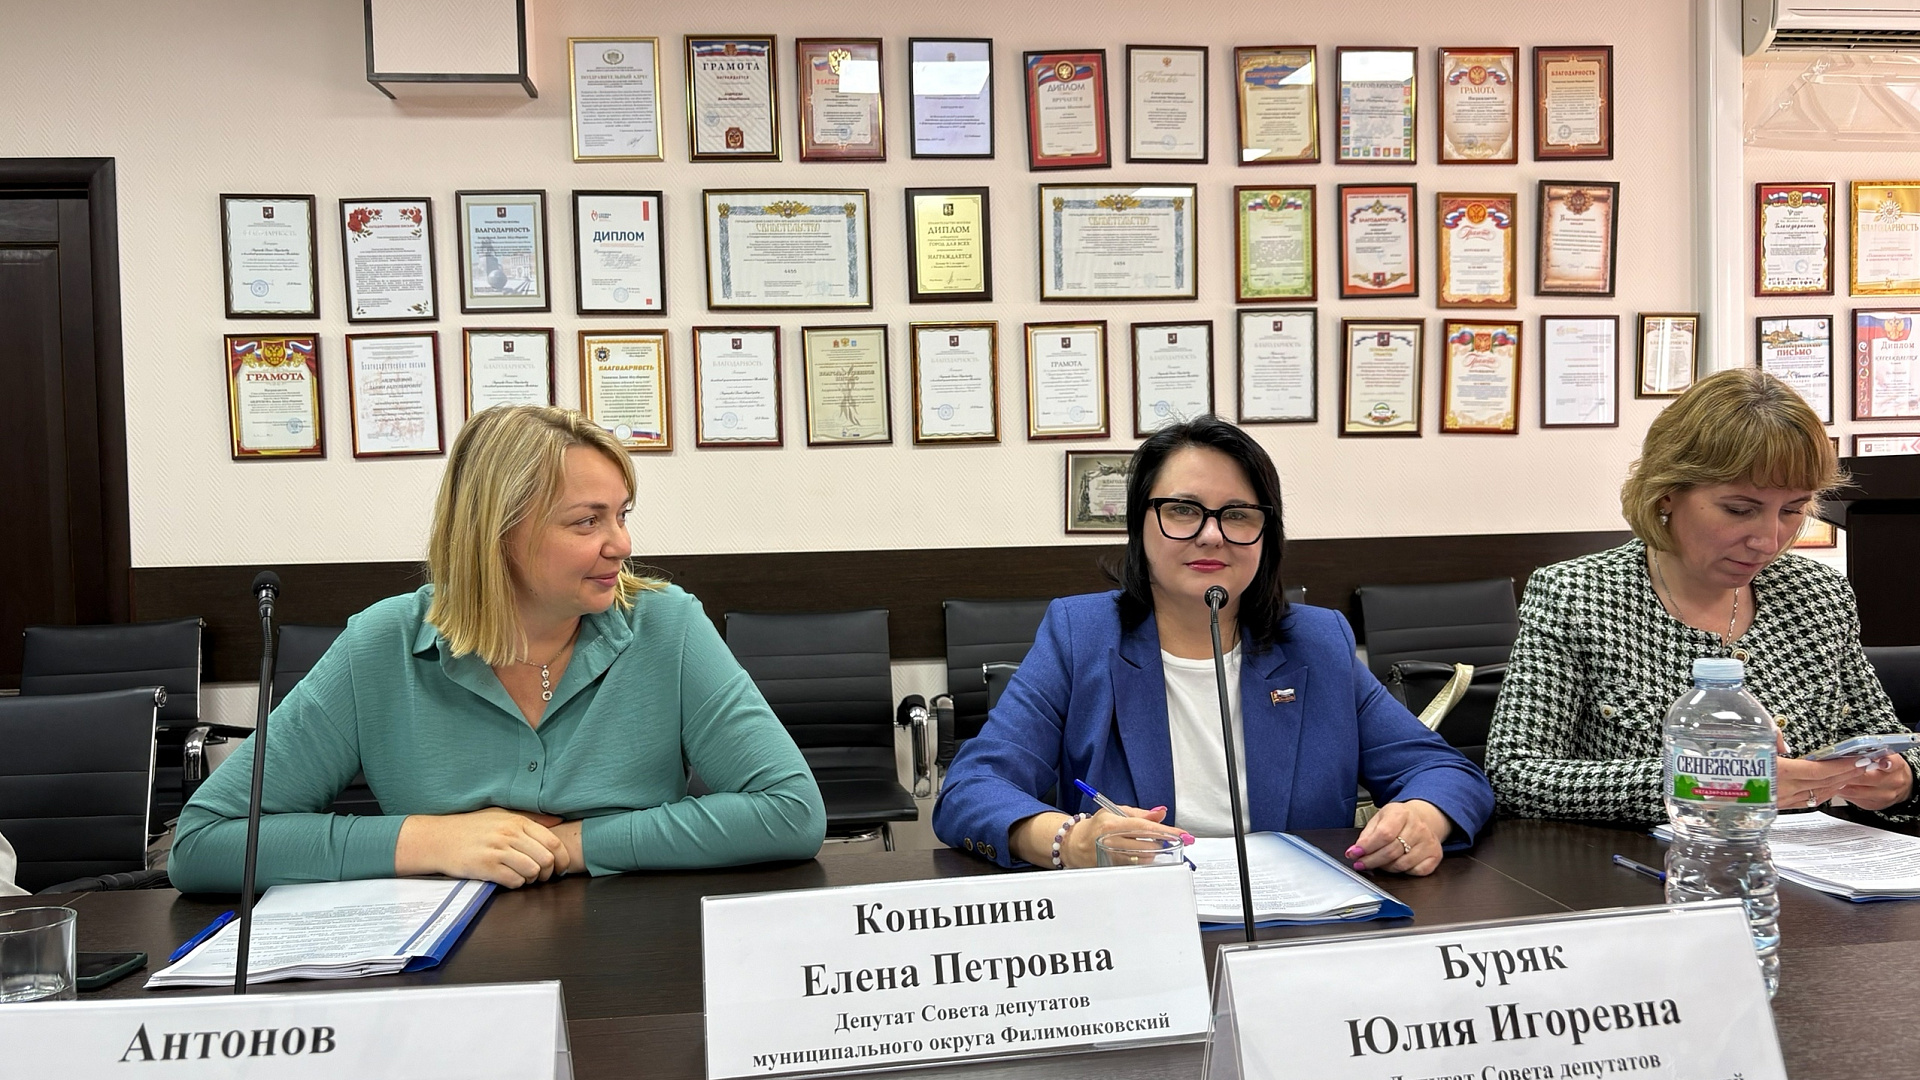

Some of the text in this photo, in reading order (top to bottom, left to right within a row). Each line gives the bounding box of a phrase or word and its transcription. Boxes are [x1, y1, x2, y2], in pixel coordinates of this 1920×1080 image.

[703, 62, 760, 71] ГРАМОТА
[592, 231, 645, 243] ДИПЛОМ
[927, 226, 970, 235] ДИПЛОМ
[246, 372, 305, 382] ГРАМОТА
[1677, 755, 1767, 777] СЕНЕЖСКАЯ
[1694, 788, 1749, 797] НЕГАЗИРОВАННАЯ
[855, 897, 1057, 936] Коньшина
[802, 947, 1115, 998] Елена Петровна
[1435, 943, 1569, 988] Буряк
[834, 993, 1091, 1033] Депутат Совета депутатов
[1345, 997, 1682, 1057] Юлия Игоревна
[118, 1023, 337, 1063] Антонов
[752, 1012, 1171, 1069] муниципального округа Филимонковский
[1481, 1053, 1662, 1080] Совета депутатов
